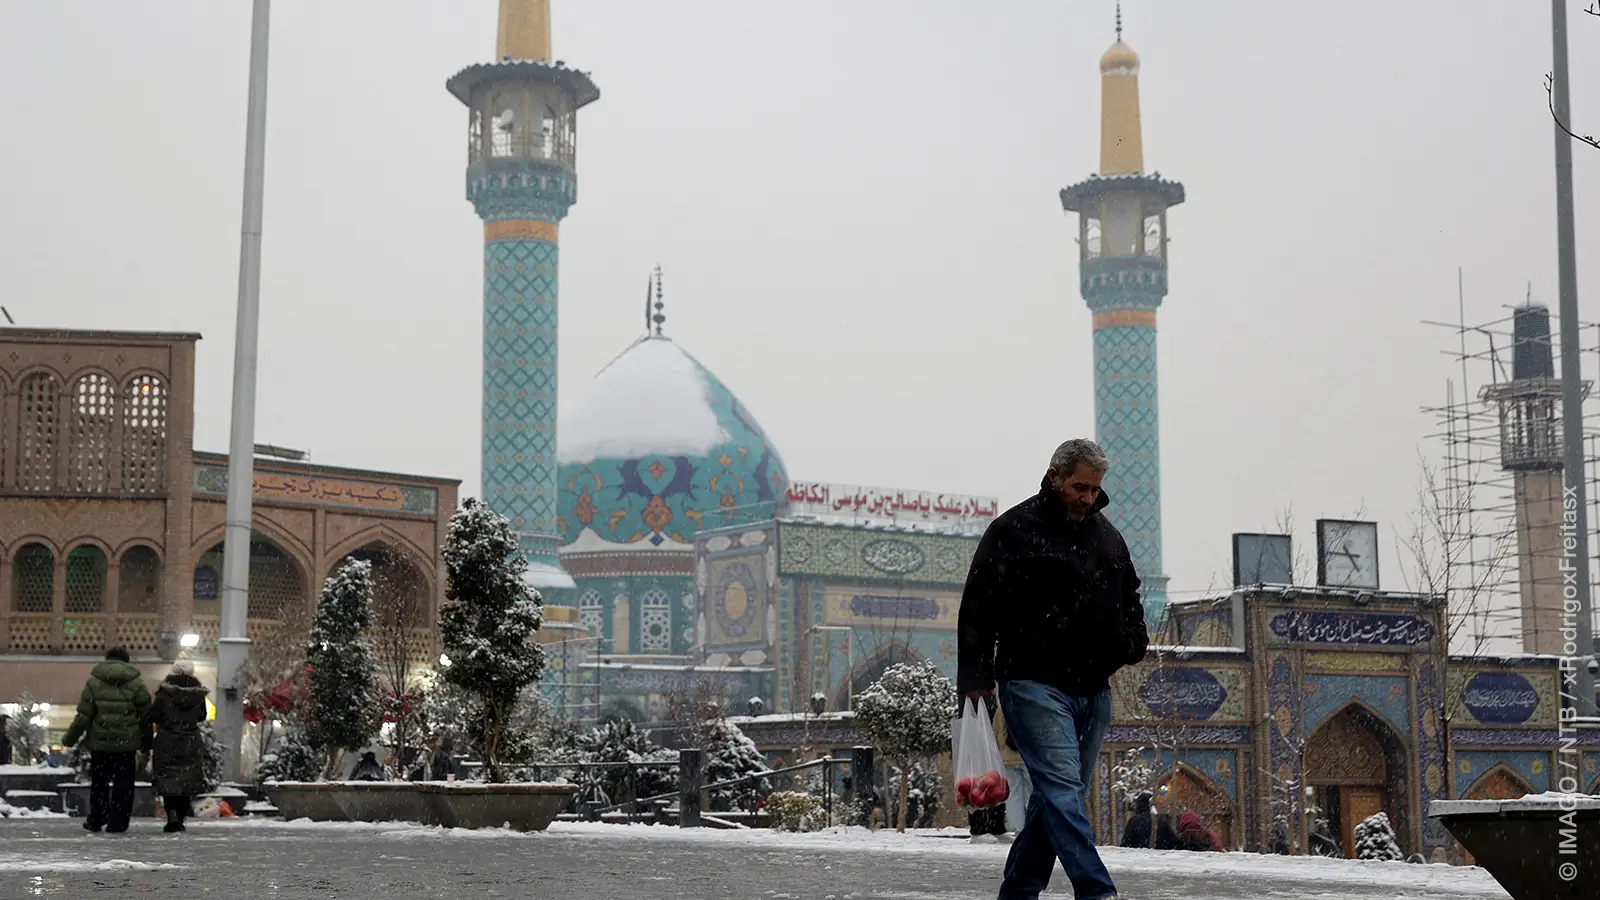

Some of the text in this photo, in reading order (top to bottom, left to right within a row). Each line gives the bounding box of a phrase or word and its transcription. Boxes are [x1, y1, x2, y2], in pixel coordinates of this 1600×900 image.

[298, 479, 342, 499] بزرگ
[346, 487, 398, 502] تکیه
[832, 493, 867, 511] موسی
[884, 493, 918, 516] صالح
[963, 498, 998, 520] السلام
[1361, 620, 1388, 643] حضرت
